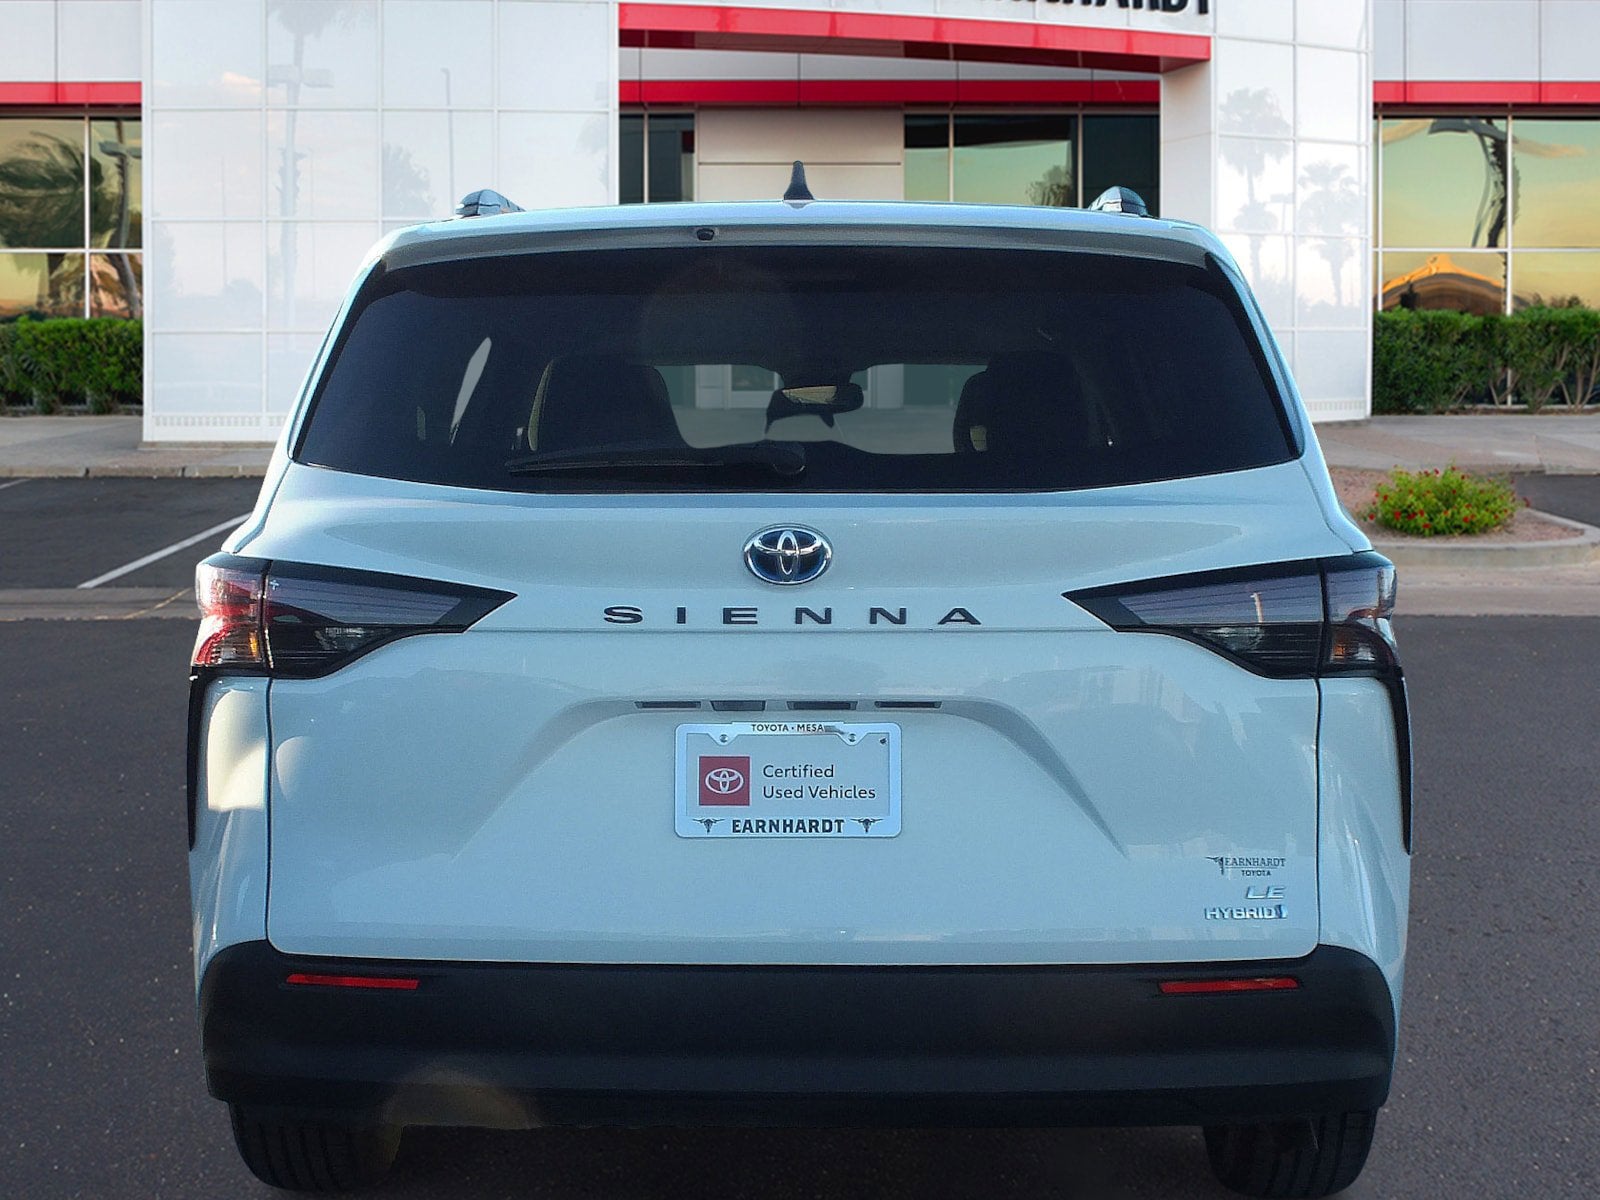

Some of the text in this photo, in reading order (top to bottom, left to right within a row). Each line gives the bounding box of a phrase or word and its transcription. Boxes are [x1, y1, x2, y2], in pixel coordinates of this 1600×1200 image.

[603, 606, 981, 625] SIENNA
[751, 724, 825, 732] TOYOTA MESA
[762, 764, 835, 778] Certified
[763, 785, 876, 799] Used Vehicles
[732, 818, 845, 834] EARNHARDT
[1224, 857, 1287, 867] EARNHARDT
[1241, 869, 1272, 877] TOYOTA
[1245, 885, 1286, 900] LE
[1204, 906, 1277, 920] HYBRID
